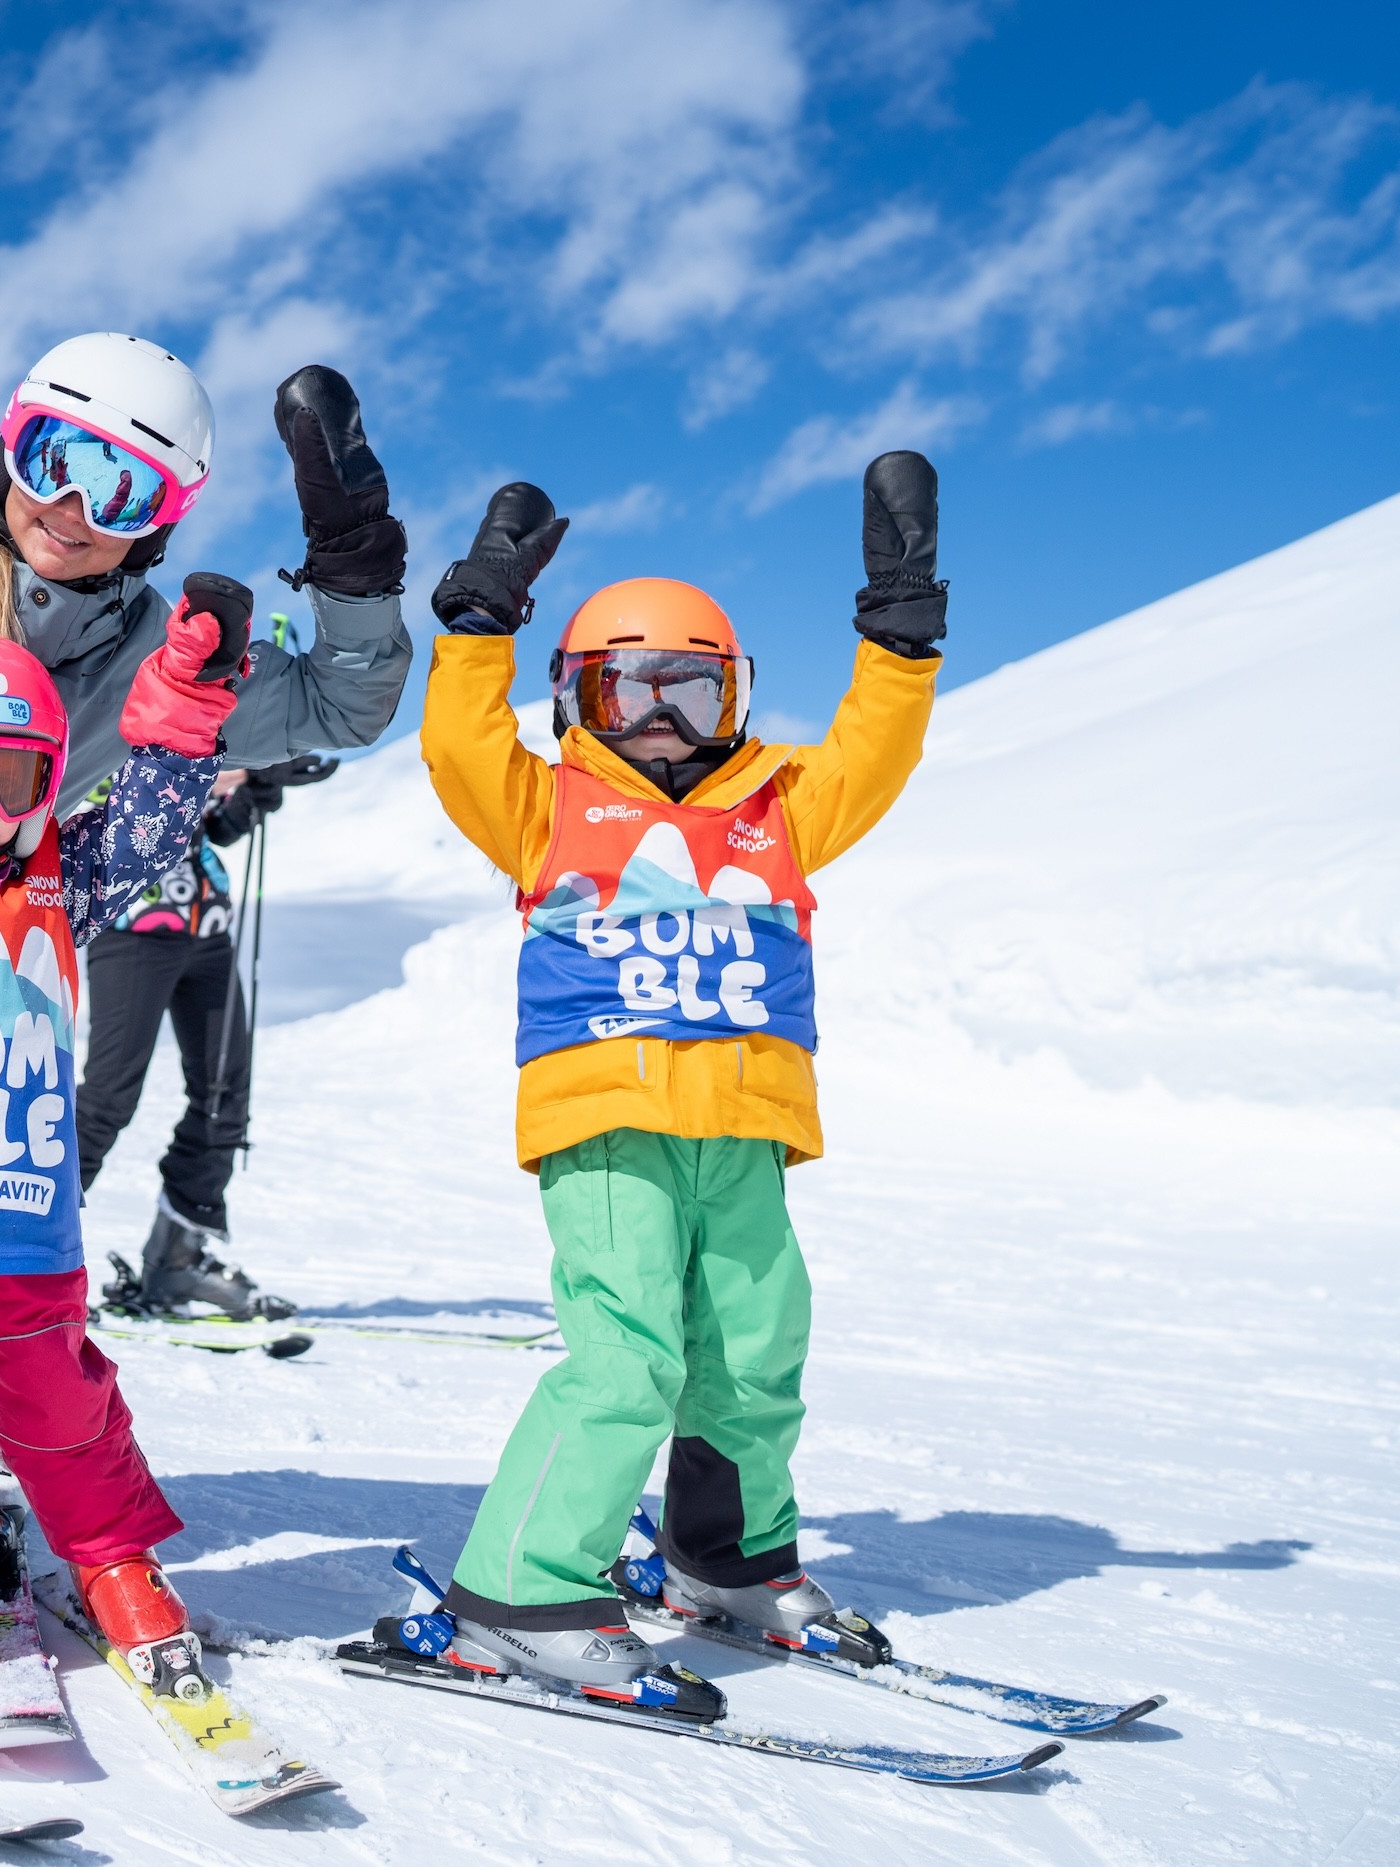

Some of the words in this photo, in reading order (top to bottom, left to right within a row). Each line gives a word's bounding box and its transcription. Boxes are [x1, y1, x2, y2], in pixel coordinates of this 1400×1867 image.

[8, 702, 27, 712] BOM
[604, 810, 643, 818] GRAVITY
[734, 818, 764, 840] SNOW
[727, 832, 777, 853] SCHOOL
[24, 875, 59, 890] SNOW
[575, 904, 755, 959] BOM
[618, 954, 770, 1027] BLE
[422, 1618, 435, 1631] TC
[486, 1626, 537, 1660] ALBELLO
